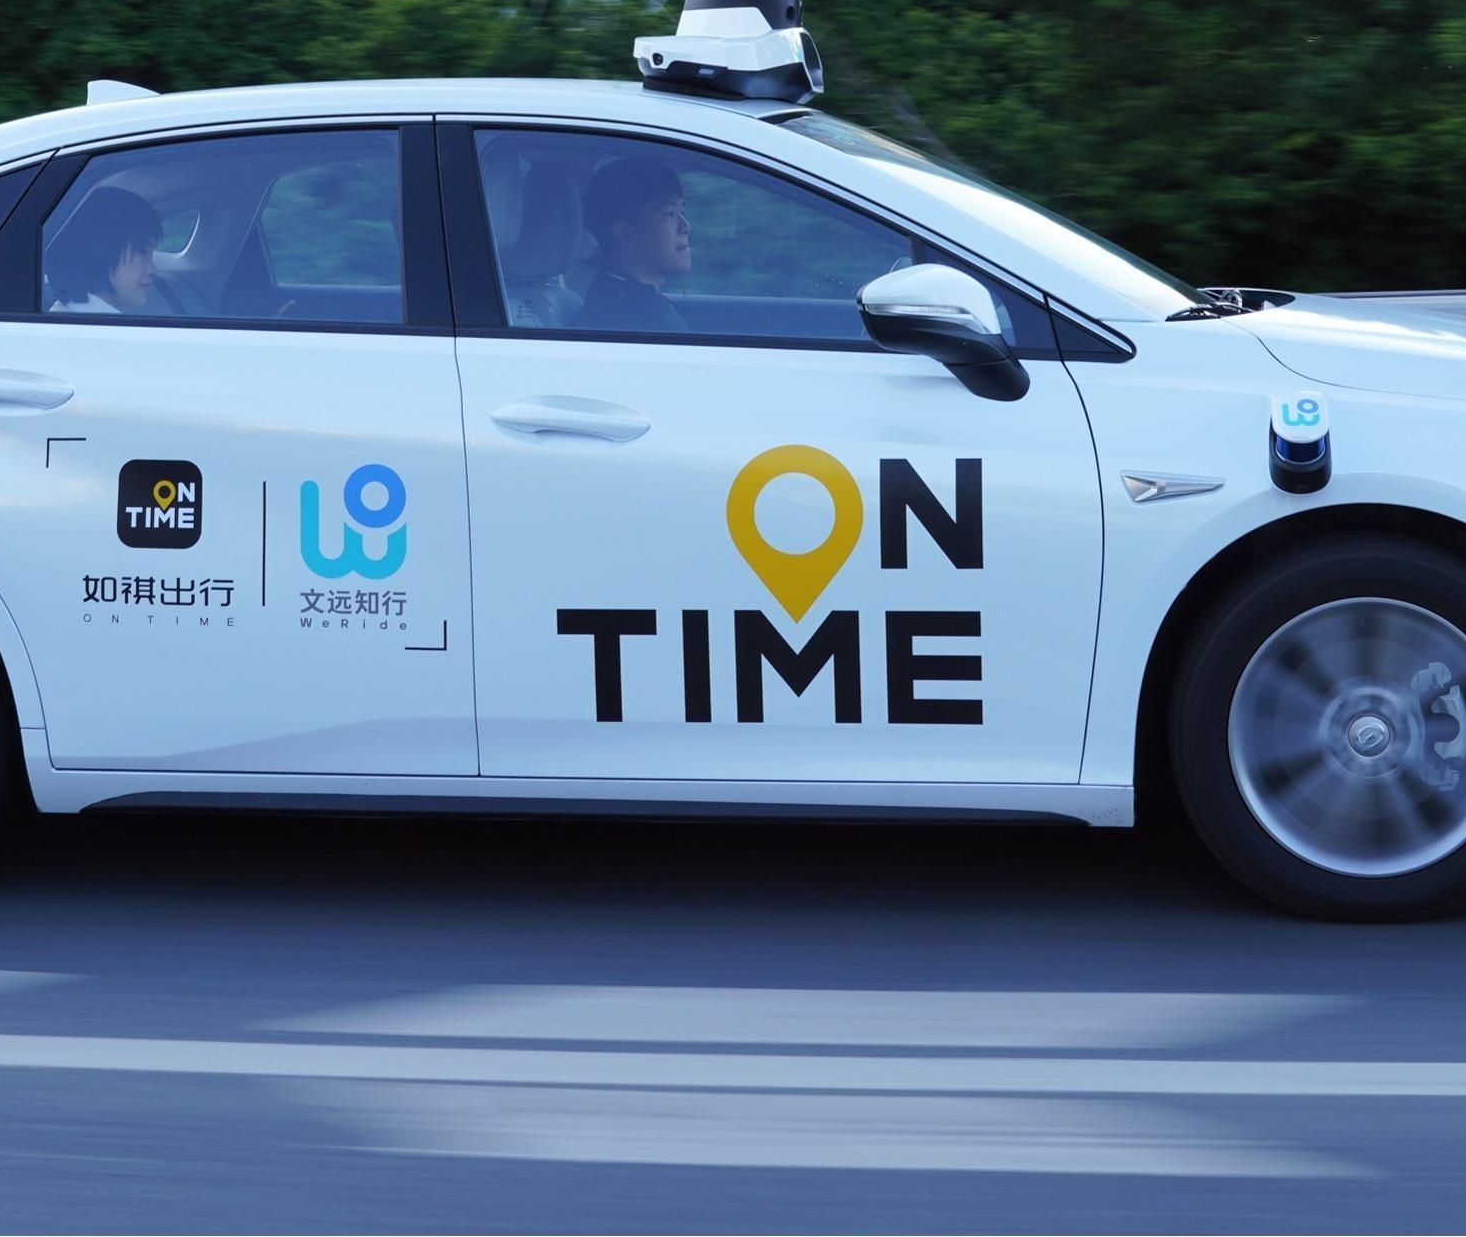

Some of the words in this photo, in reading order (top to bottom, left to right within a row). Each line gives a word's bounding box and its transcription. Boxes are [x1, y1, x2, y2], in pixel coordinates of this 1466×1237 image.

[153, 479, 196, 510] ON
[125, 506, 195, 529] TIME
[726, 444, 984, 624] ON
[82, 574, 235, 607] 如祺出行
[299, 587, 407, 617] 文远知行
[299, 617, 408, 631] WeRide
[556, 608, 984, 725] TIME
